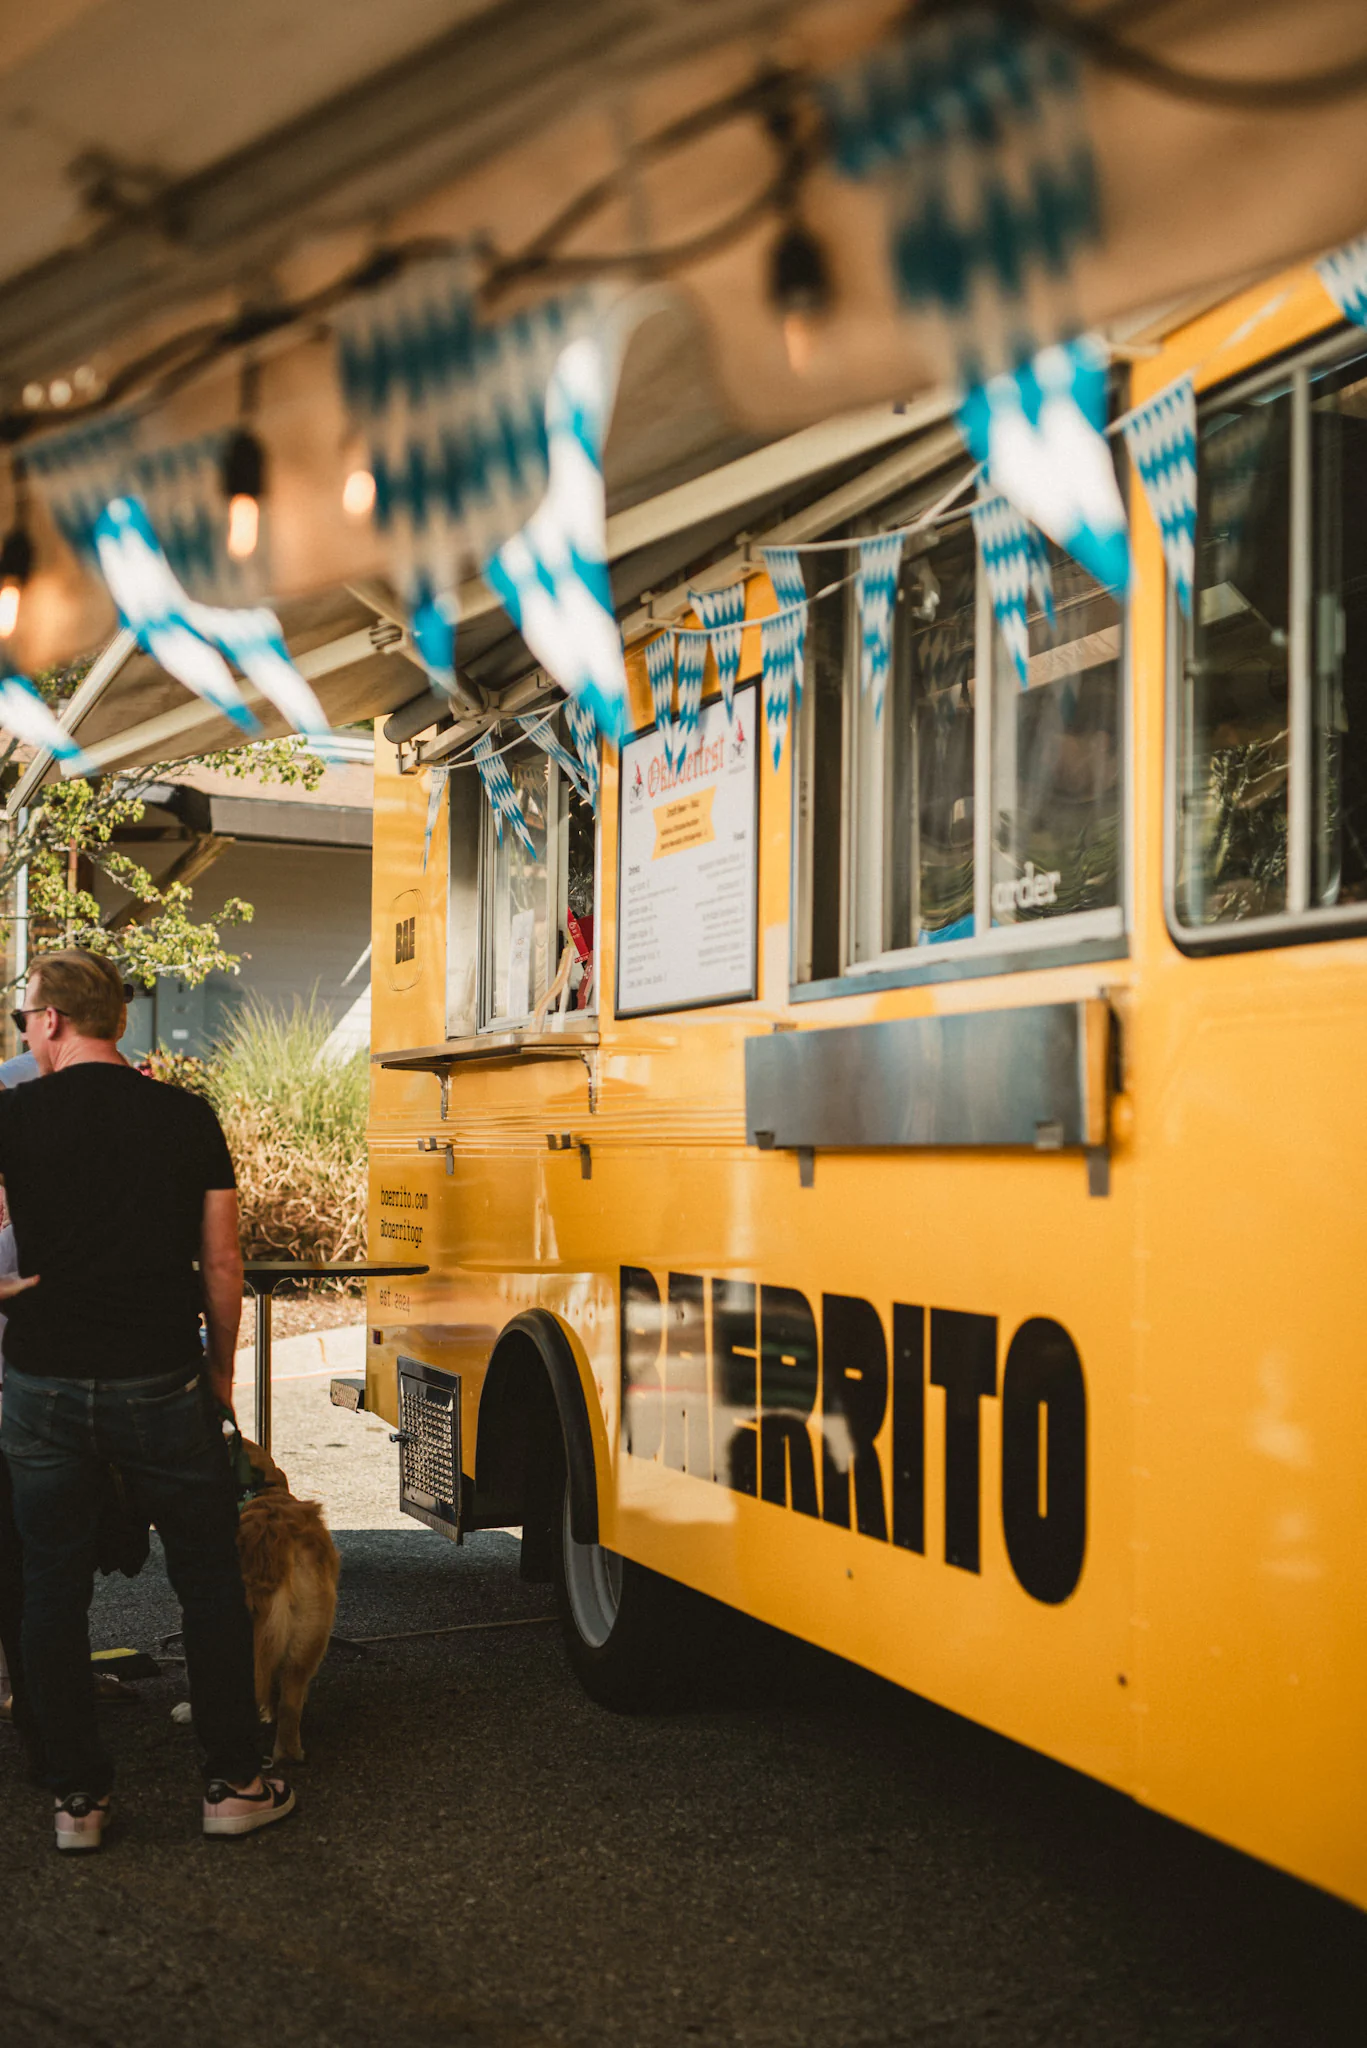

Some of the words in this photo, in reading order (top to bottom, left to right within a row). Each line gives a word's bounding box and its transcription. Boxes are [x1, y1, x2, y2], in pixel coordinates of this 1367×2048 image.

[395, 916, 415, 965] BAE
[379, 1285, 391, 1307] est
[619, 1264, 1088, 1607] BAERRITO
